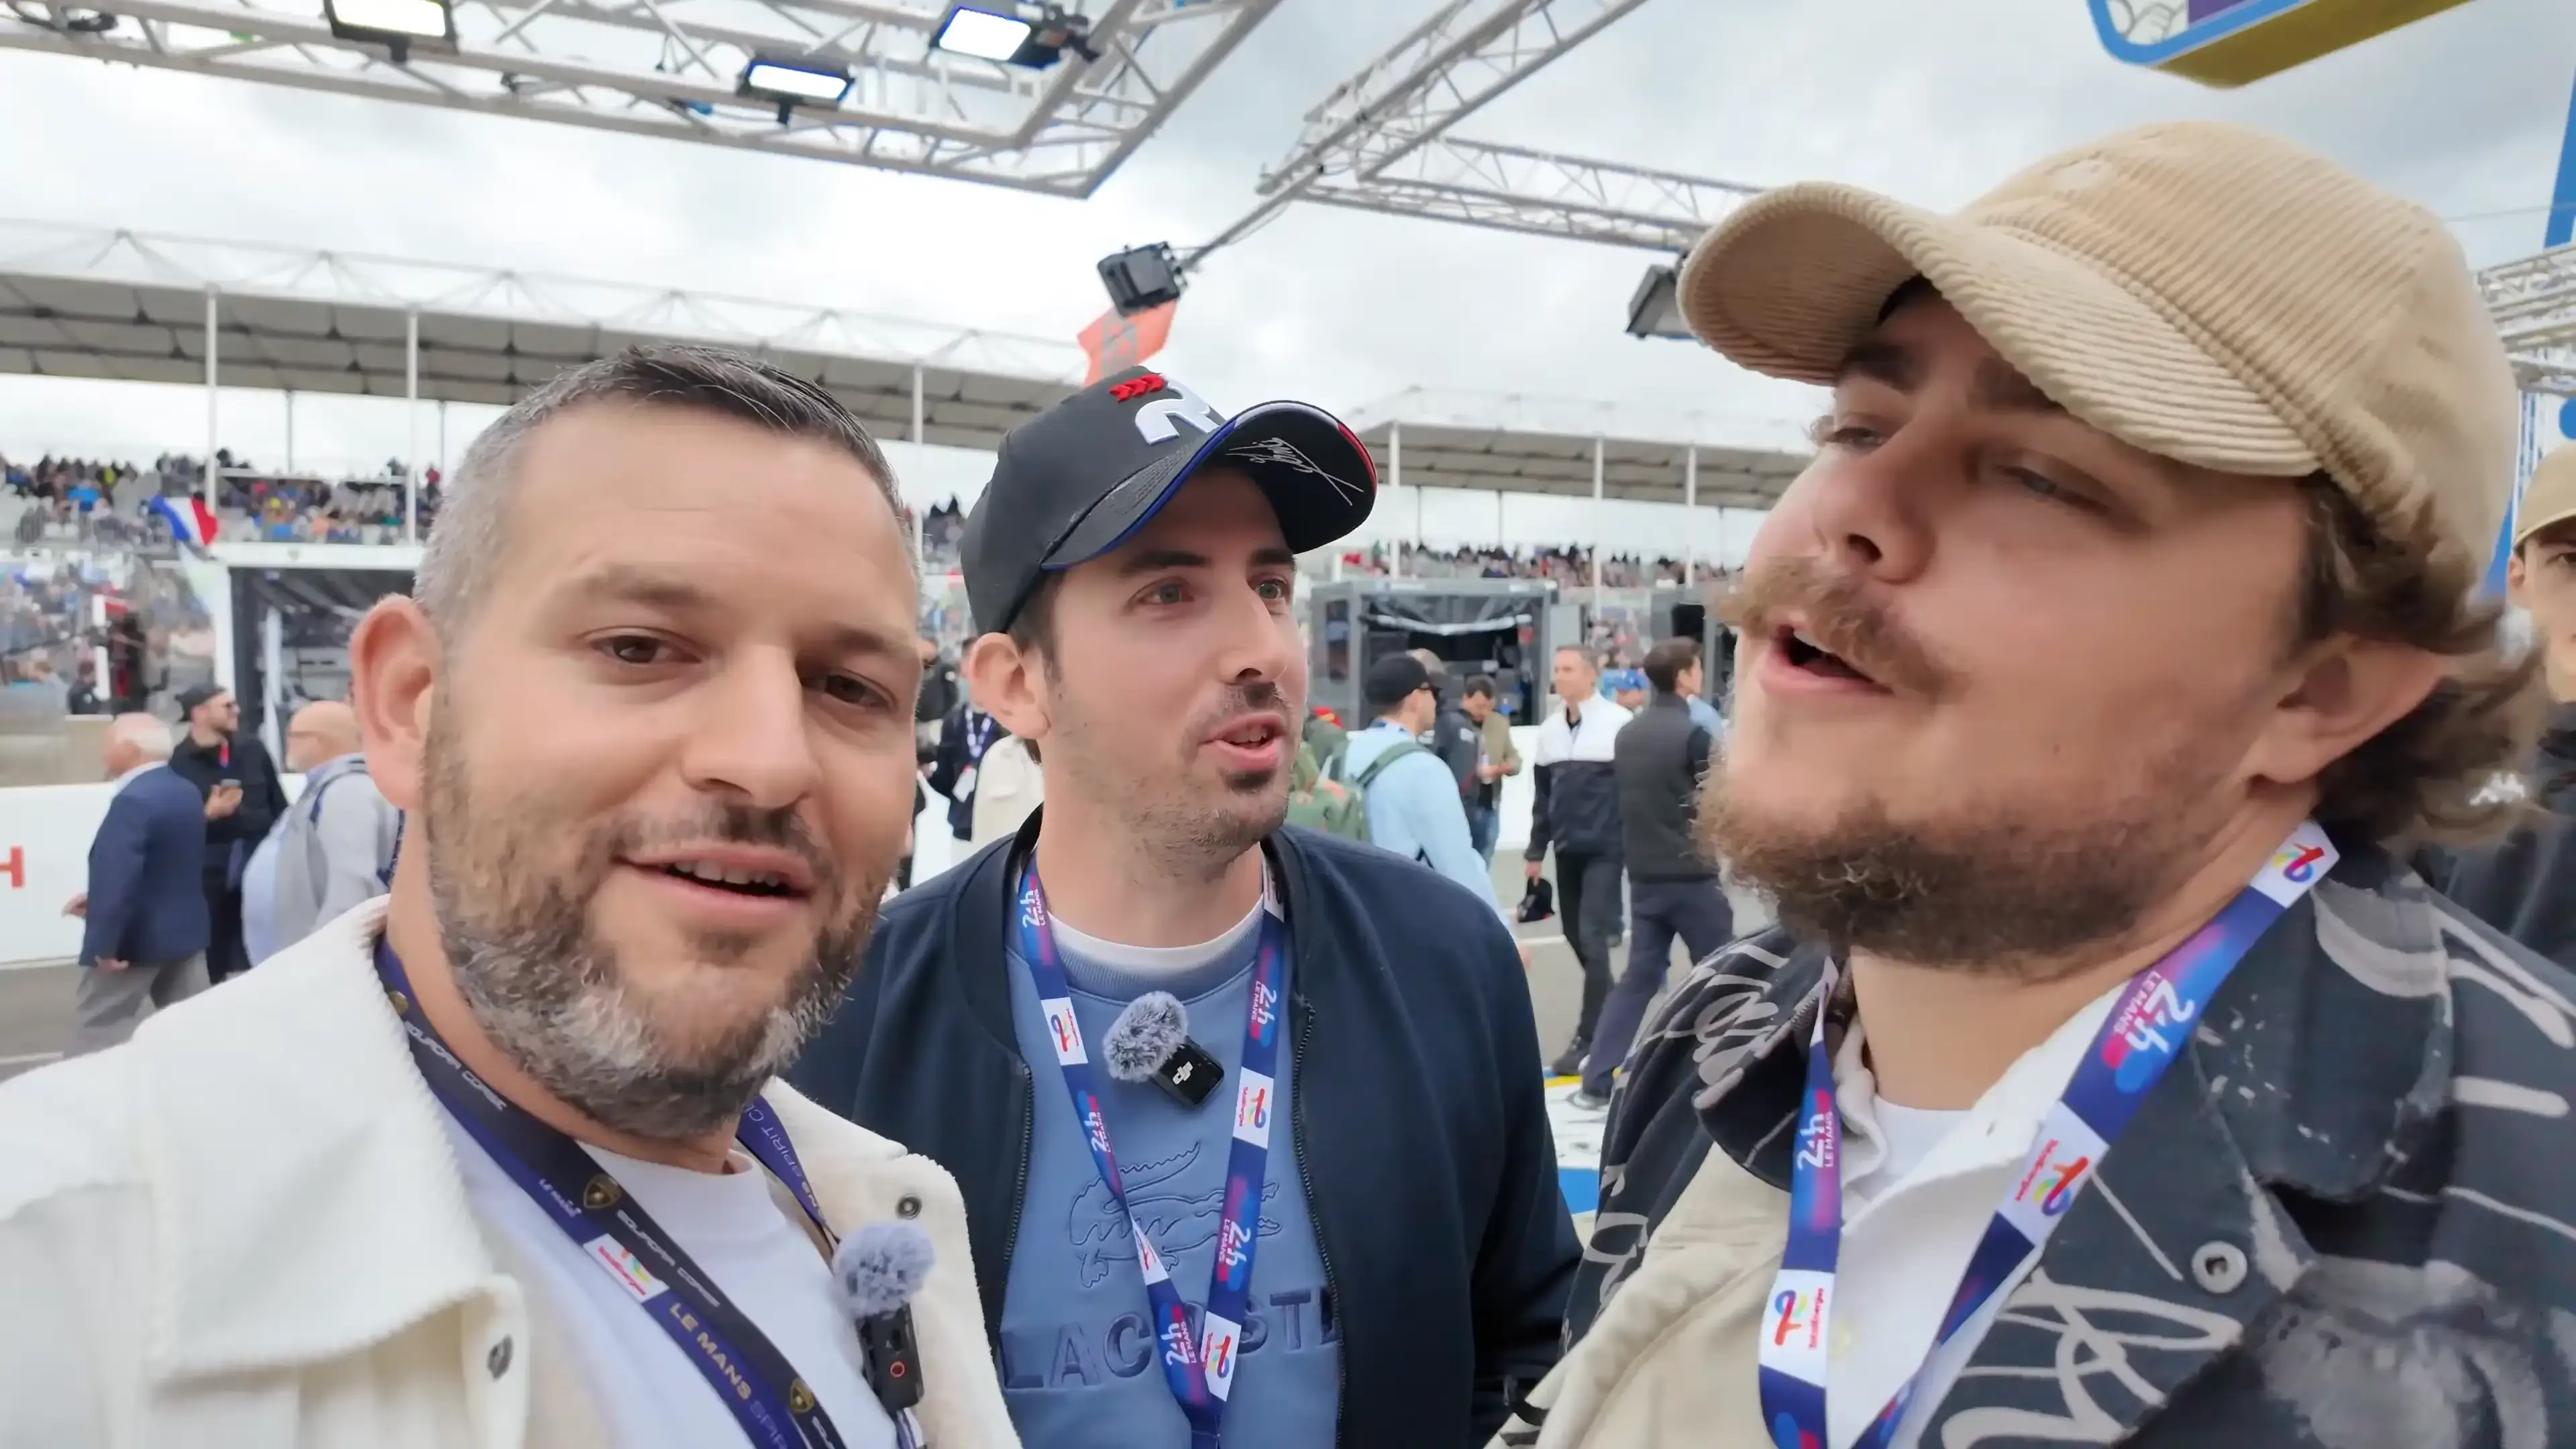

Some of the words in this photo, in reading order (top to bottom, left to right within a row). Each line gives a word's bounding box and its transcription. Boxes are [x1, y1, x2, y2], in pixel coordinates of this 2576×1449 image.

[1255, 980, 1261, 992] LE
[2144, 971, 2162, 992] LE
[2113, 989, 2149, 1034] MANS
[1824, 1112, 1833, 1149] MANS
[1824, 1150, 1833, 1167] LE
[1224, 1219, 1230, 1230] LE
[1219, 1232, 1227, 1261] MANS
[1181, 1321, 1193, 1351] MANS
[670, 1303, 698, 1332] LE
[697, 1332, 751, 1399] MANS
